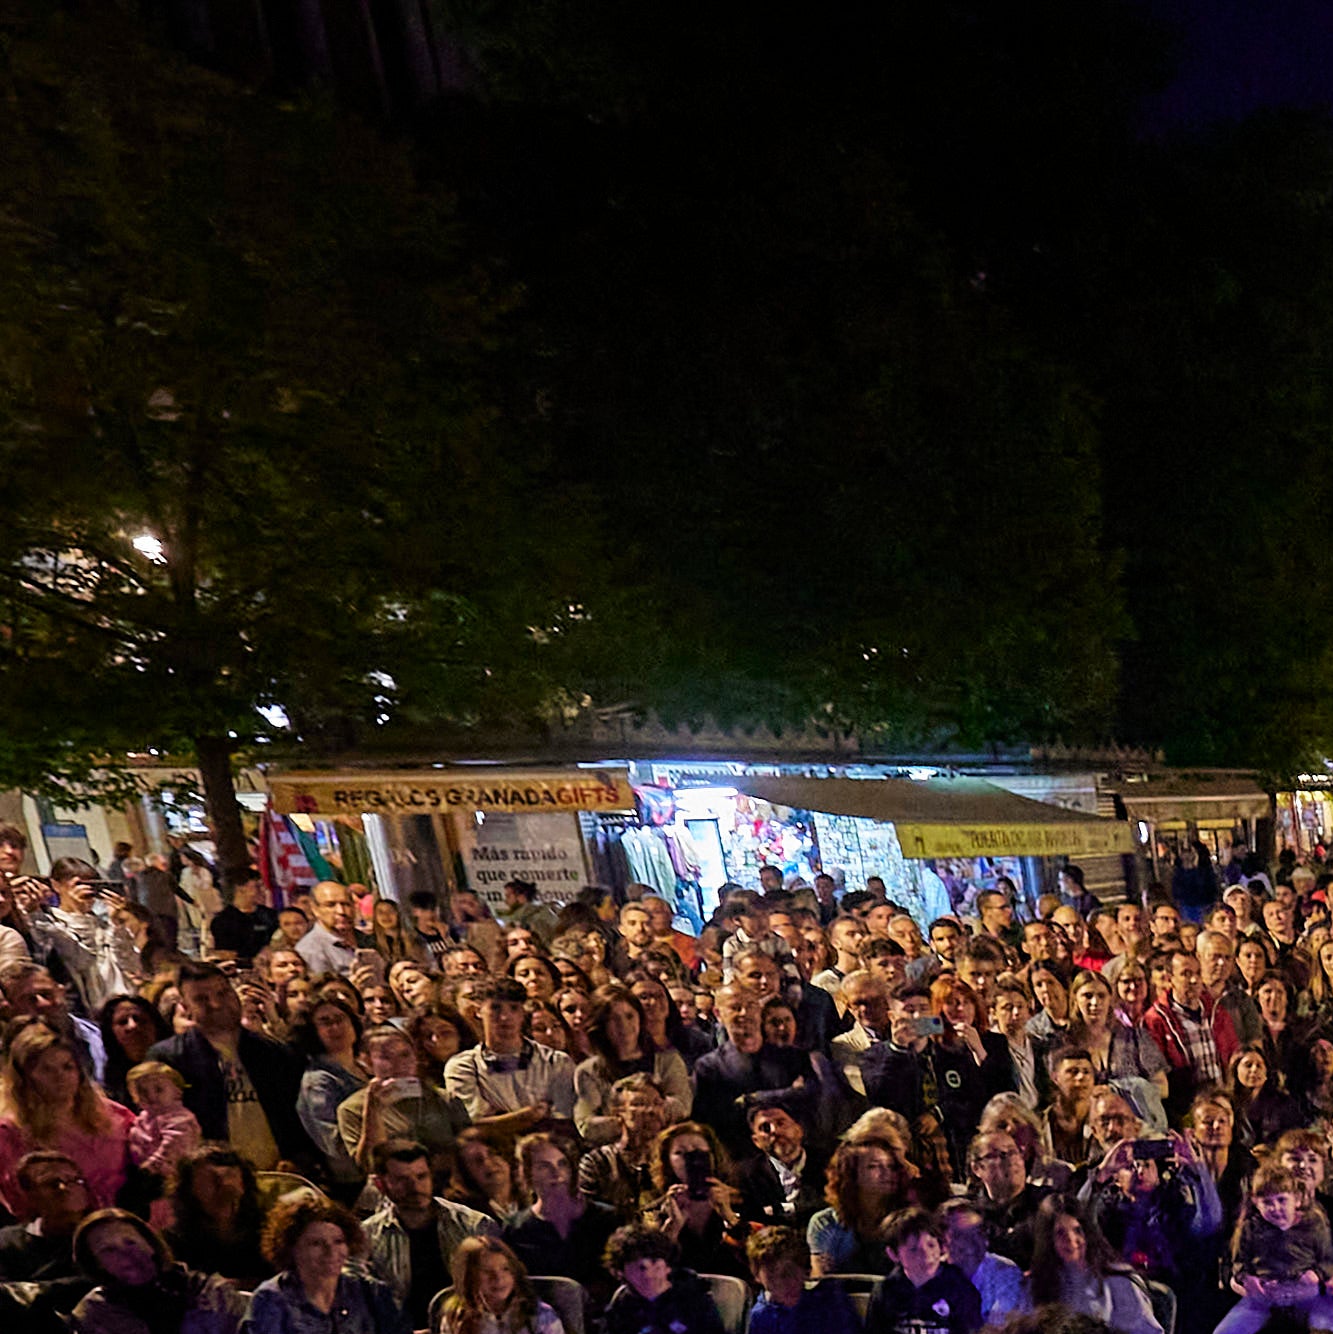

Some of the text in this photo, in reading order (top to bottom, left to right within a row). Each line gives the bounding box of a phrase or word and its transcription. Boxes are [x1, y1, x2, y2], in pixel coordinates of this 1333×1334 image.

[473, 845, 508, 861] Más
[477, 868, 579, 884] que comerte
